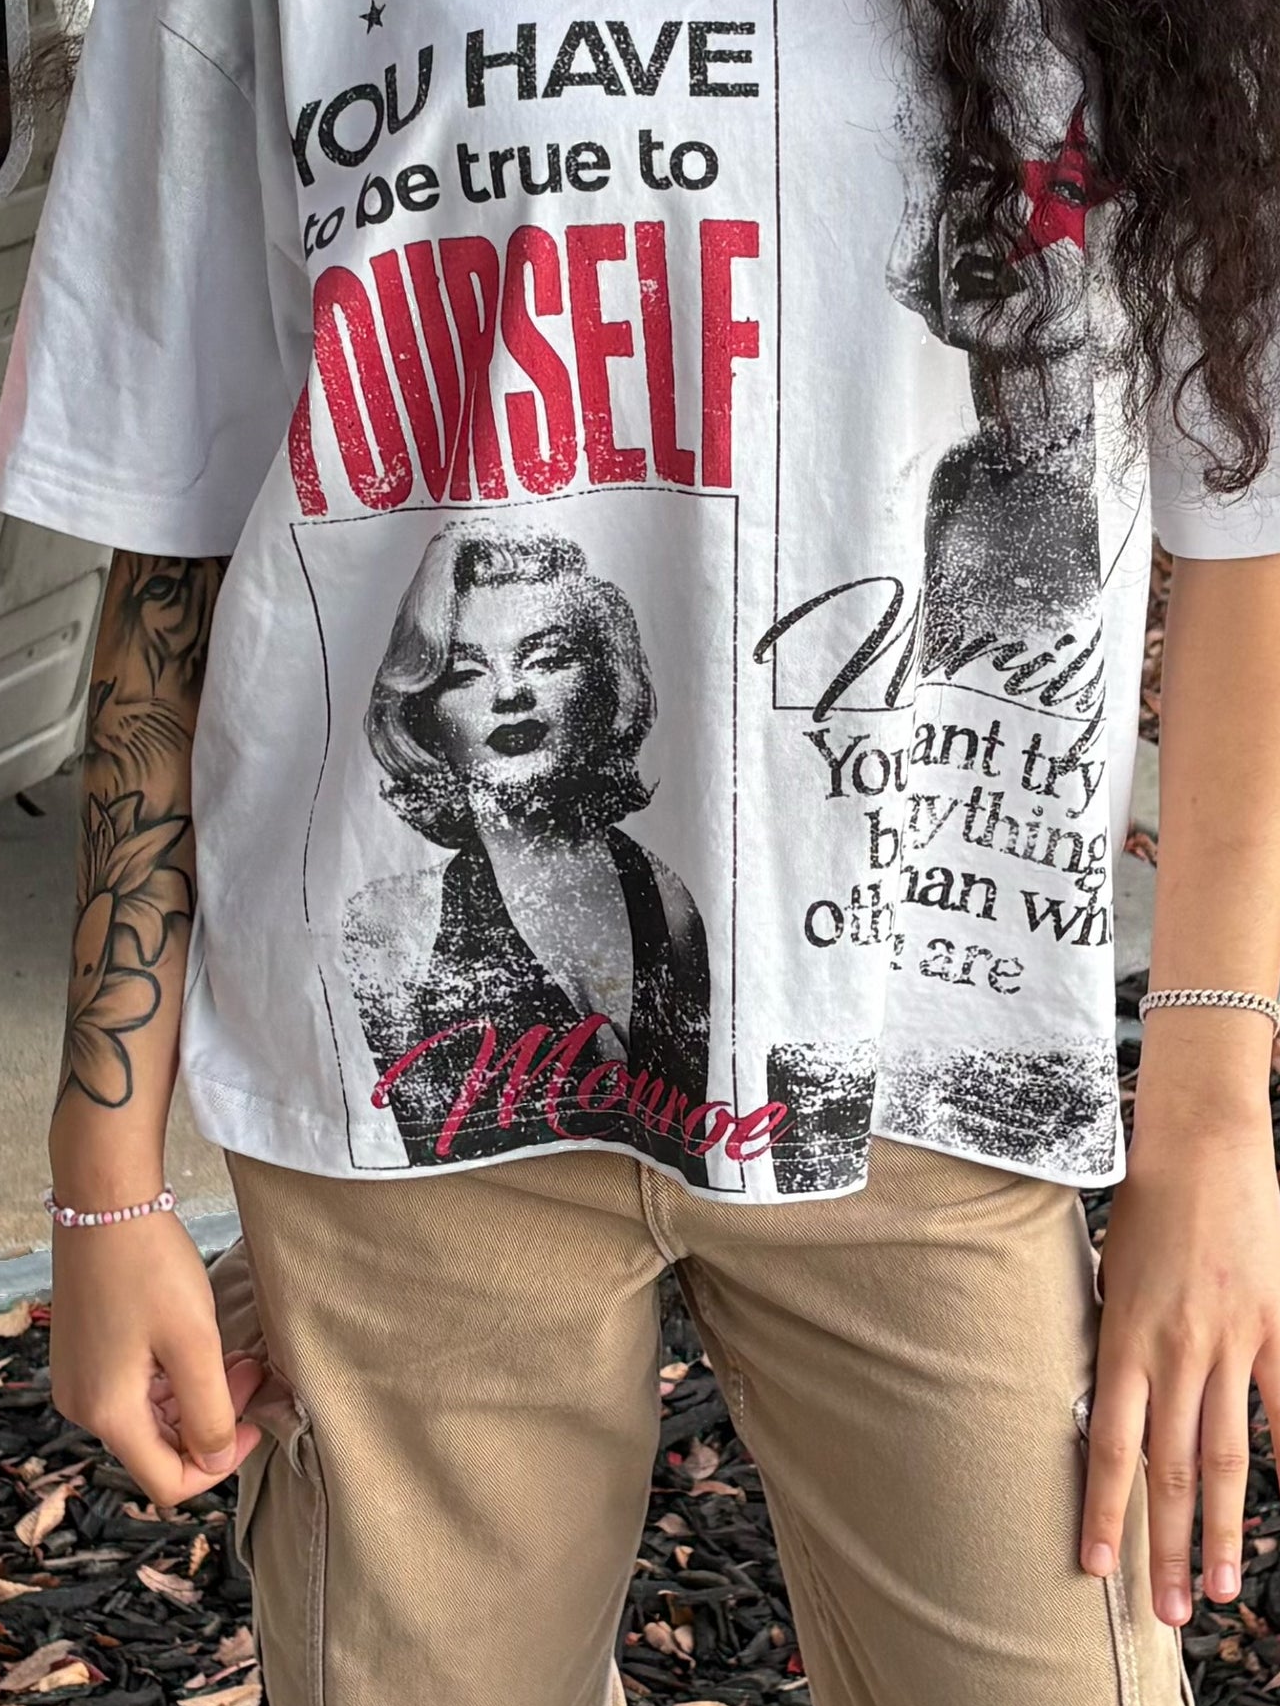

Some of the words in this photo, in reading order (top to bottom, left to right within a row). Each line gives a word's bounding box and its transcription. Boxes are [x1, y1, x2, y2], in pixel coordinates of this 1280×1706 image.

[290, 43, 434, 188] YOU
[464, 19, 760, 109] HAVE
[303, 205, 346, 261] to
[355, 163, 441, 230] be
[456, 139, 612, 204] true
[637, 129, 720, 192] to
[369, 1012, 797, 1162] Monroe
